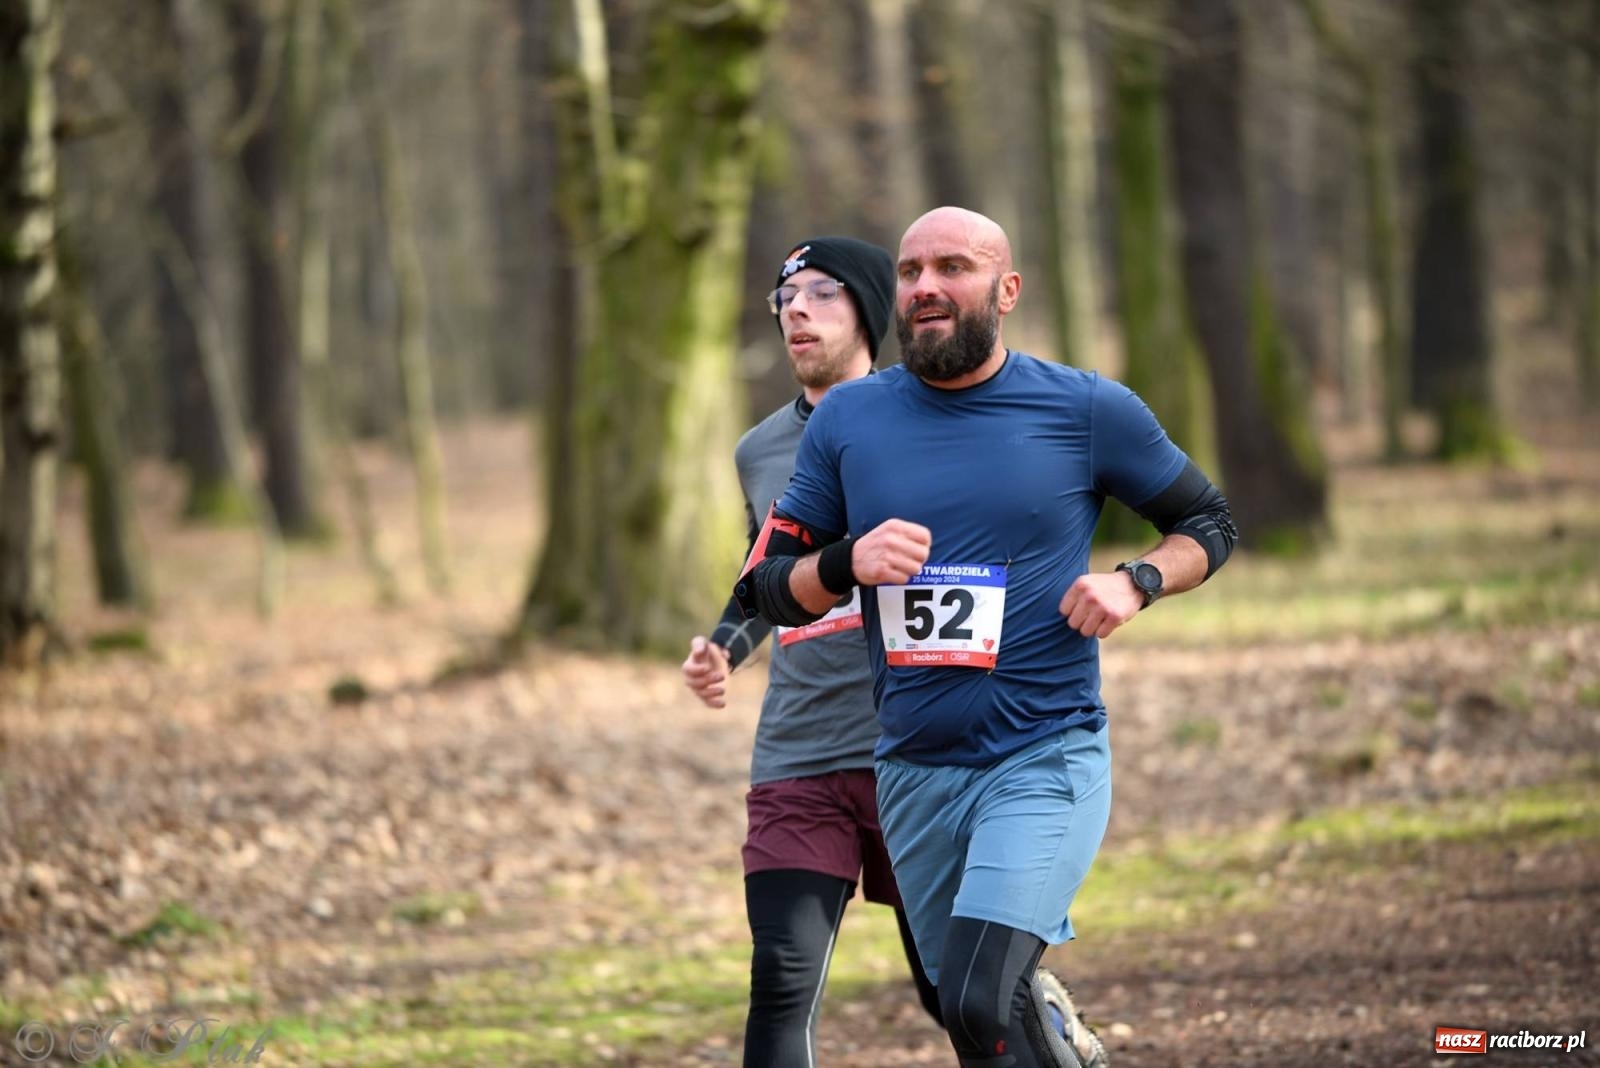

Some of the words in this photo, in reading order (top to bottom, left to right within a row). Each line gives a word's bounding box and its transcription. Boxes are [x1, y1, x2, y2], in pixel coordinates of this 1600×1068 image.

[924, 566, 990, 577] TWARDZIELA
[922, 576, 942, 584] lutego
[904, 588, 975, 640] 52
[912, 653, 943, 661] Racibórz
